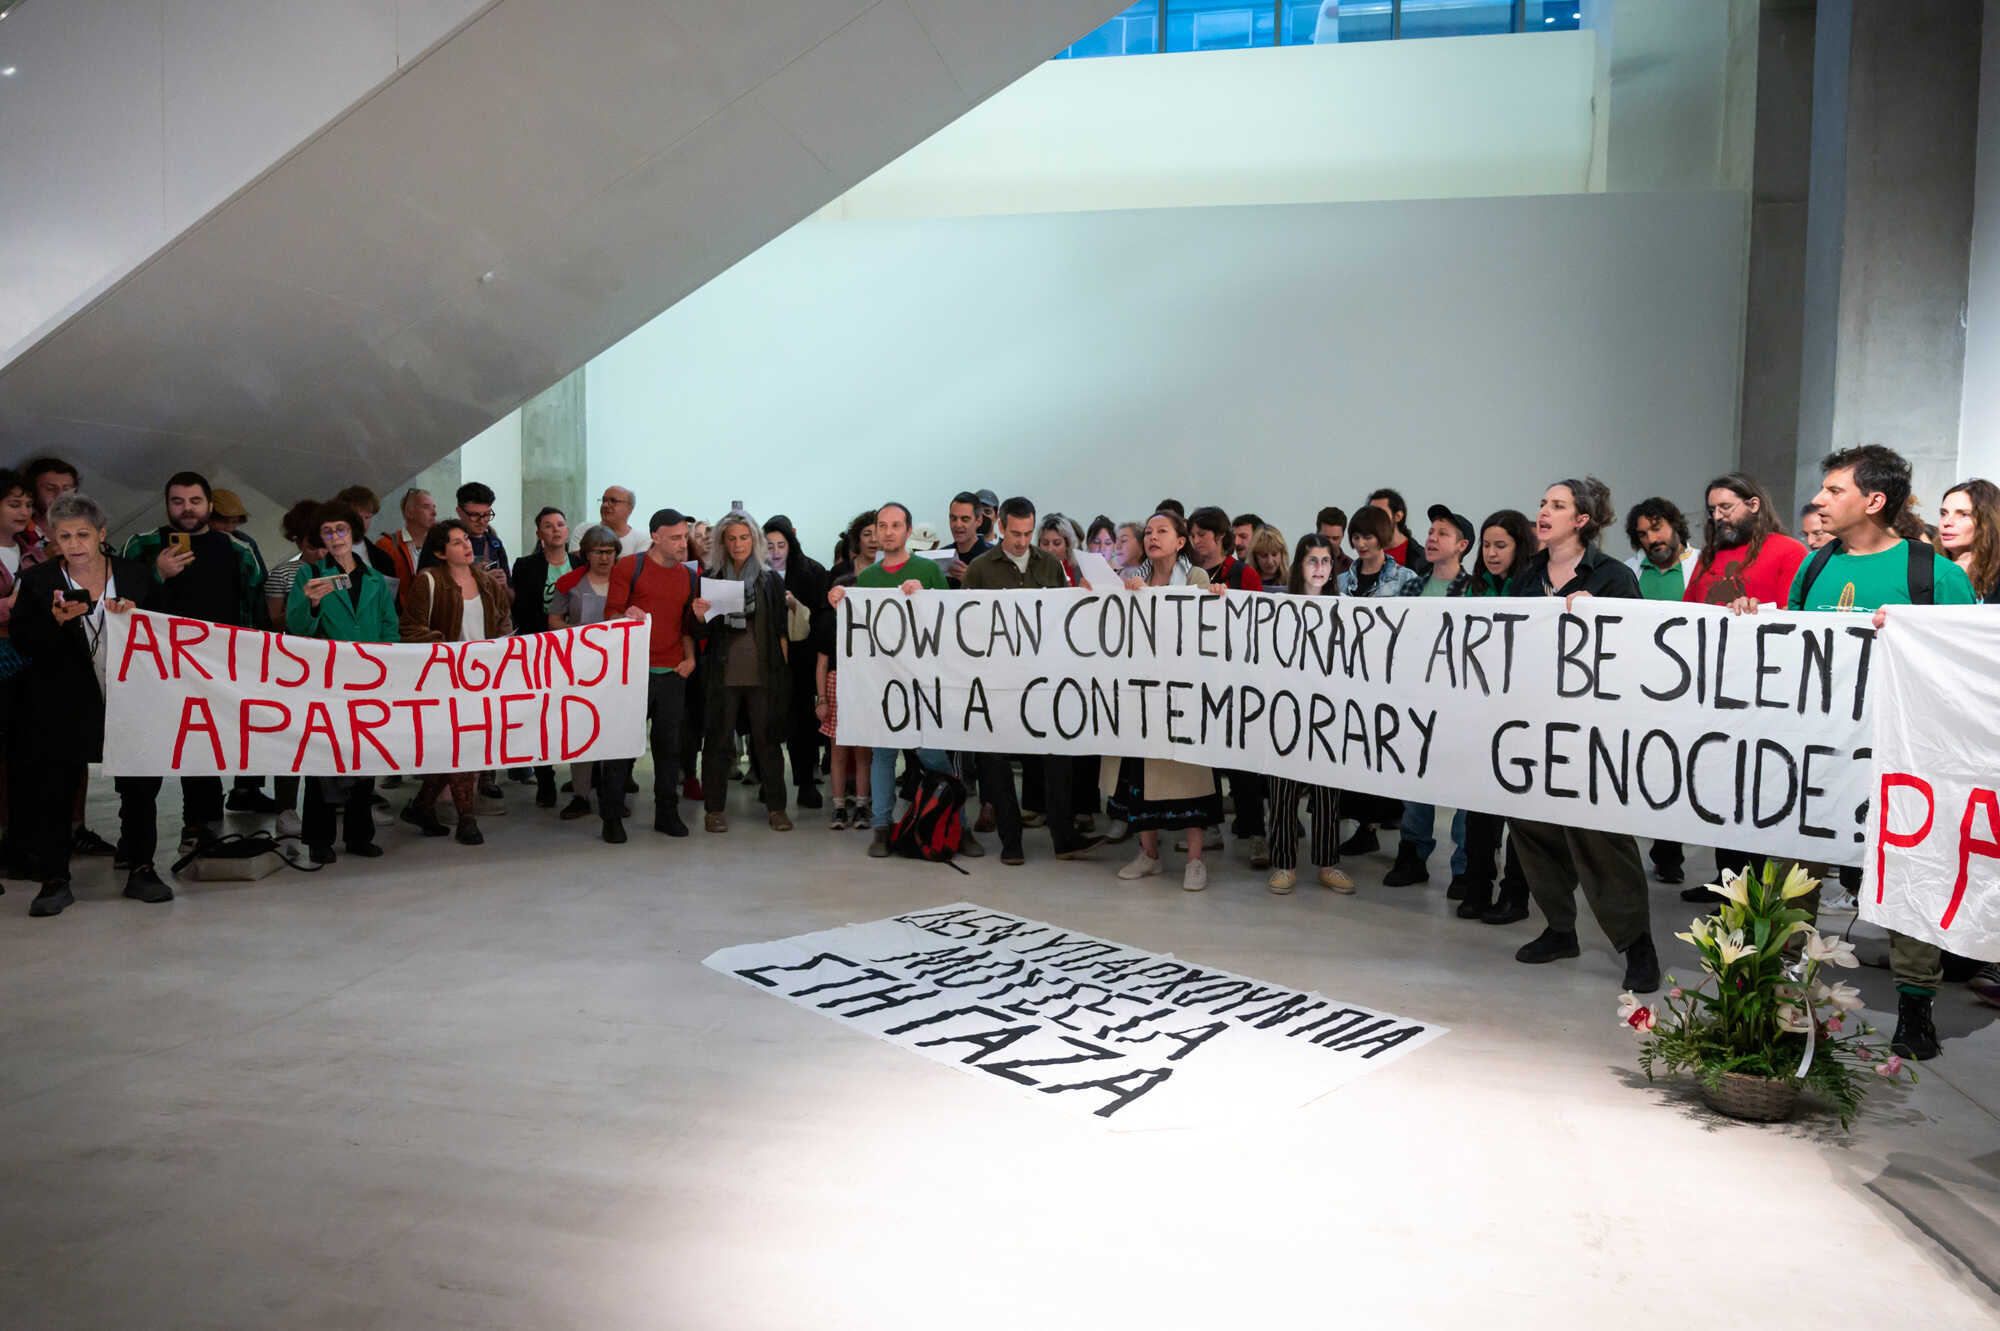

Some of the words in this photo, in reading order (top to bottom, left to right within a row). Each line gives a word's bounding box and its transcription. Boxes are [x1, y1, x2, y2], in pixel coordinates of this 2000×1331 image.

[117, 613, 393, 691] ARTISTS
[414, 619, 646, 693] AGAINST
[844, 596, 945, 659] HOW
[955, 598, 1043, 658] CAN
[1065, 594, 1410, 685] CONTEMPORARY
[1425, 611, 1530, 697] ART
[1556, 613, 1623, 701] BE
[1640, 615, 1878, 722] SILENT
[171, 692, 602, 774] APARTHEID
[881, 676, 944, 733] ON
[963, 676, 994, 733] A
[1020, 675, 1438, 779] CONTEMPORARY
[733, 952, 943, 1018] ΣΤΗ
[883, 1004, 1174, 1119] ΓΑΖΑ
